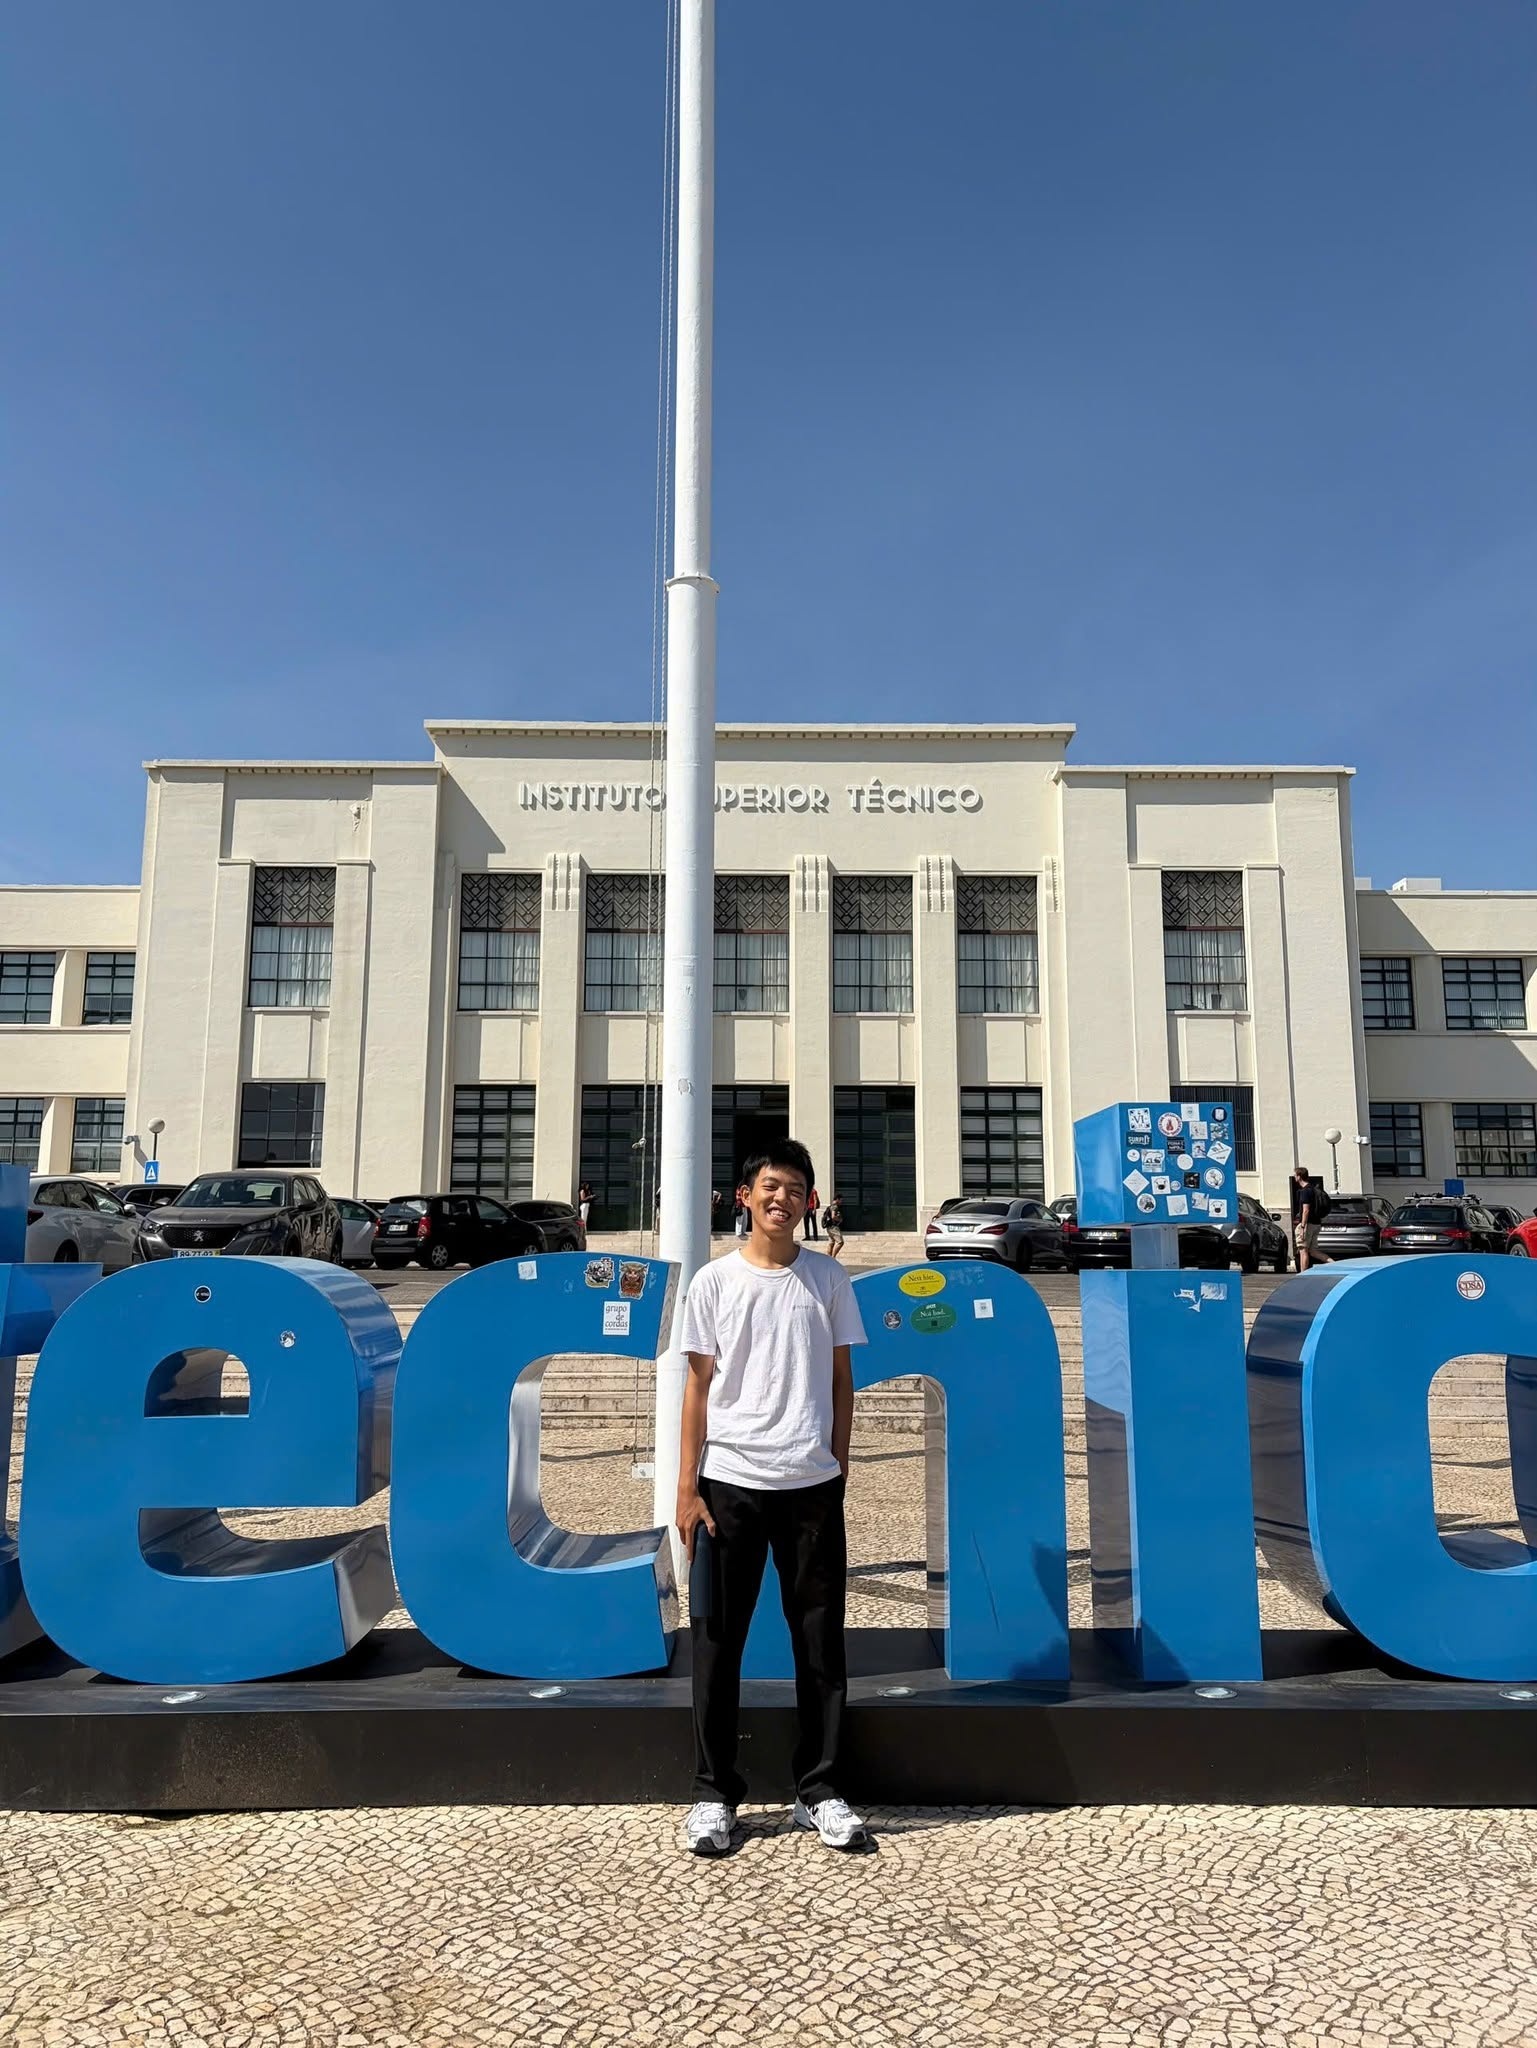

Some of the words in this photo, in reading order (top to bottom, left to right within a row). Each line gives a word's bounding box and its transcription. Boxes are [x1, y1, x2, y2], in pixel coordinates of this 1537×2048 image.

[518, 782, 667, 811] INSTITUTO
[715, 783, 830, 813] PERIOR
[846, 776, 984, 813] TÉCNICO
[605, 1305, 628, 1314] grupo
[604, 1318, 629, 1328] cordas
